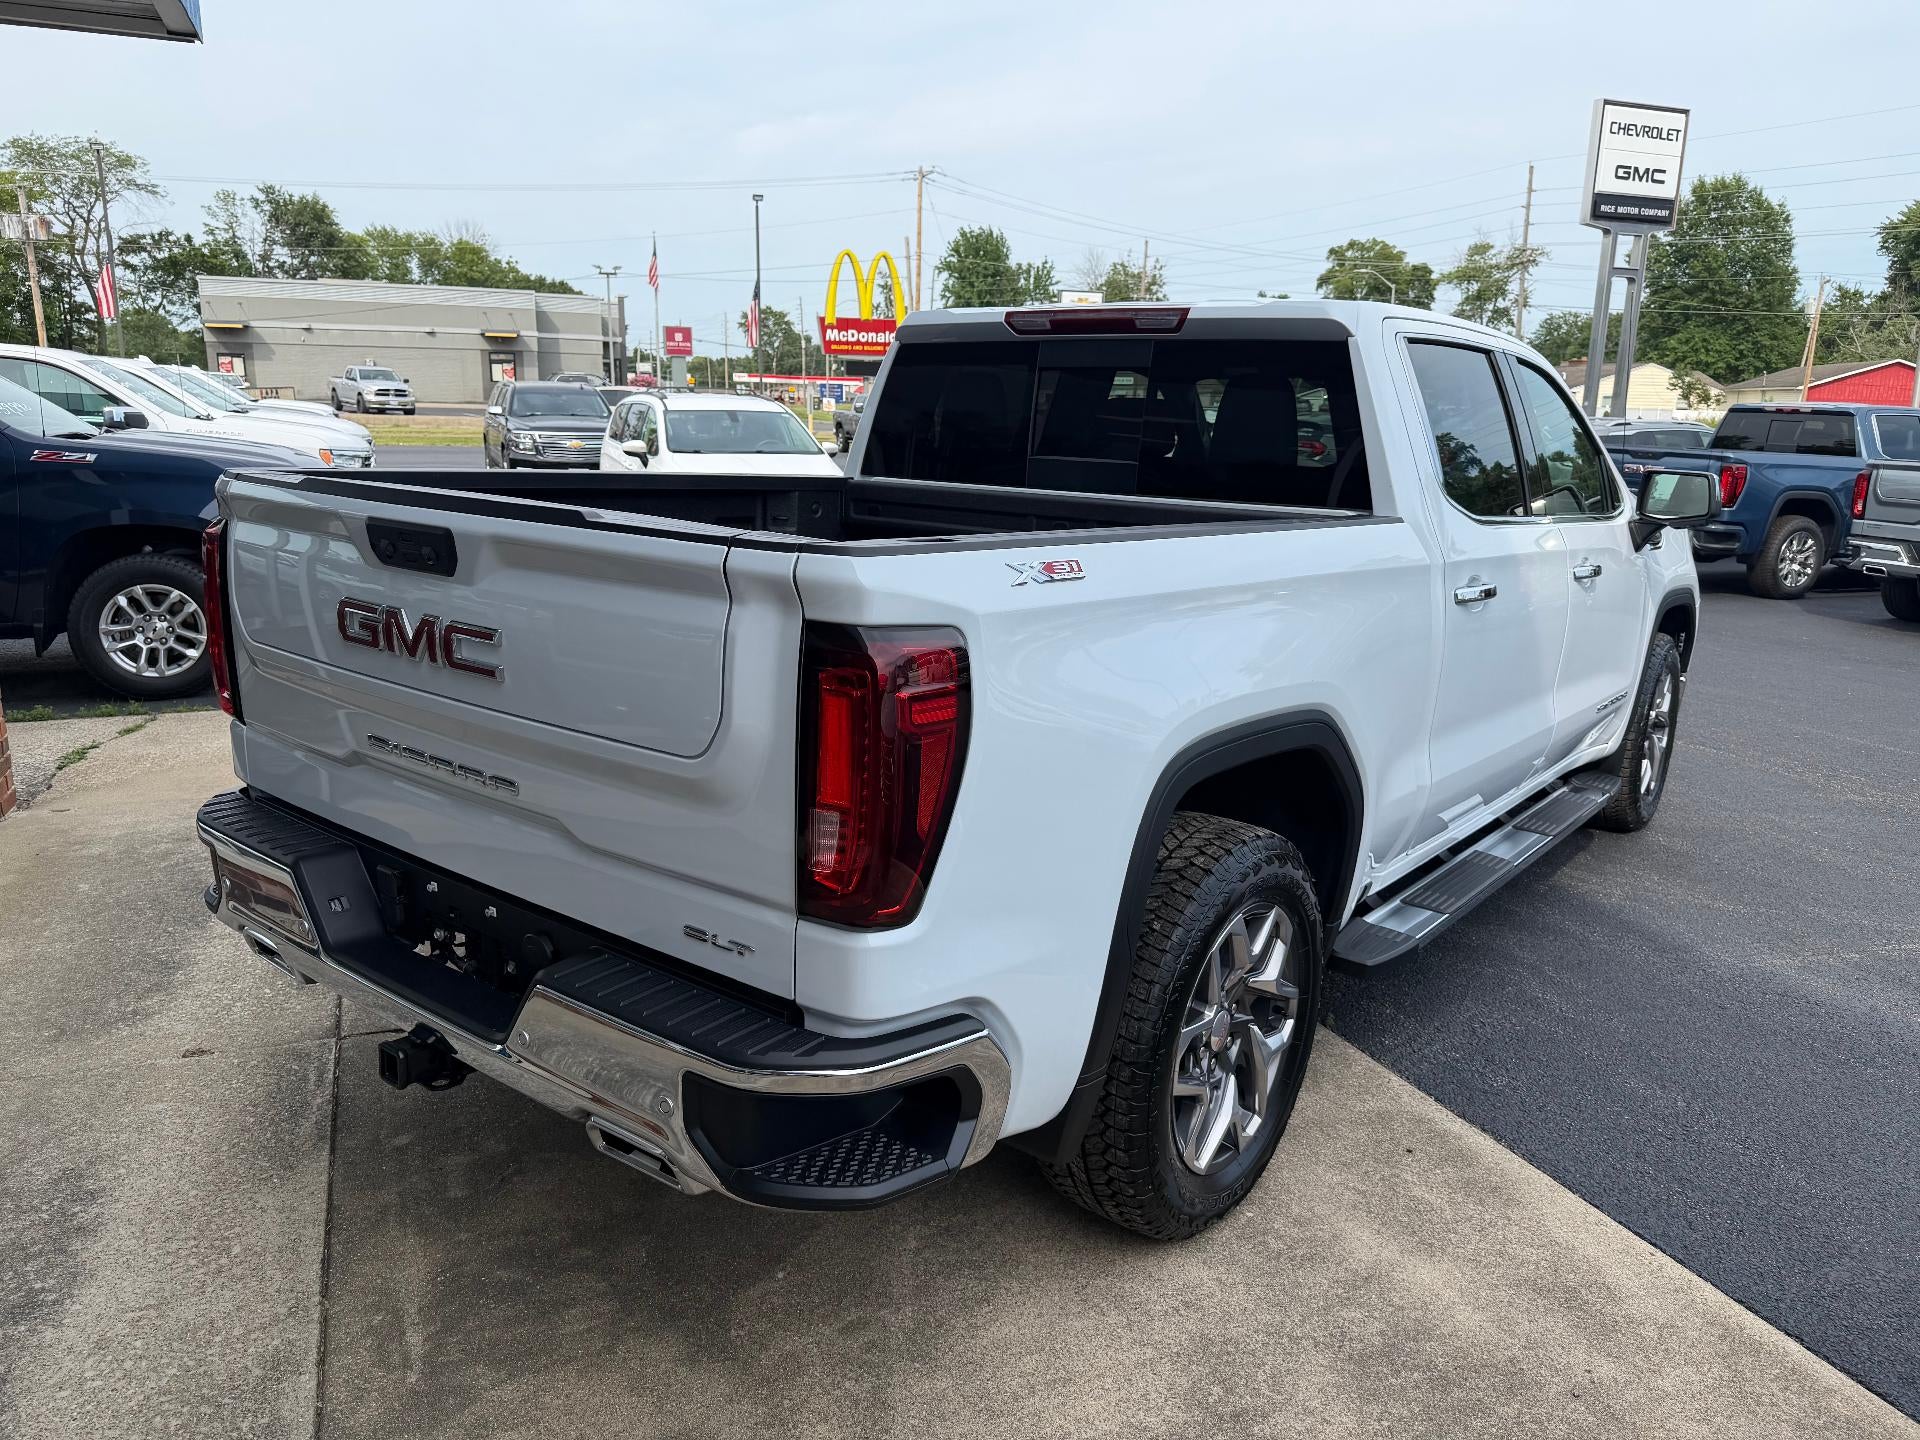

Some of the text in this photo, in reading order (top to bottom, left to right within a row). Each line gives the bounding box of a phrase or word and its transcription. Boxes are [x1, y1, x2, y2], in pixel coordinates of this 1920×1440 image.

[1609, 121, 1682, 142] CHEVROLET
[1614, 164, 1667, 185] GMC
[1600, 204, 1670, 217] RICE MOTOR COMPANY
[29, 450, 99, 464] Z71
[337, 596, 505, 682] GMC
[367, 733, 520, 798] SIERRA
[683, 924, 756, 957] SLT
